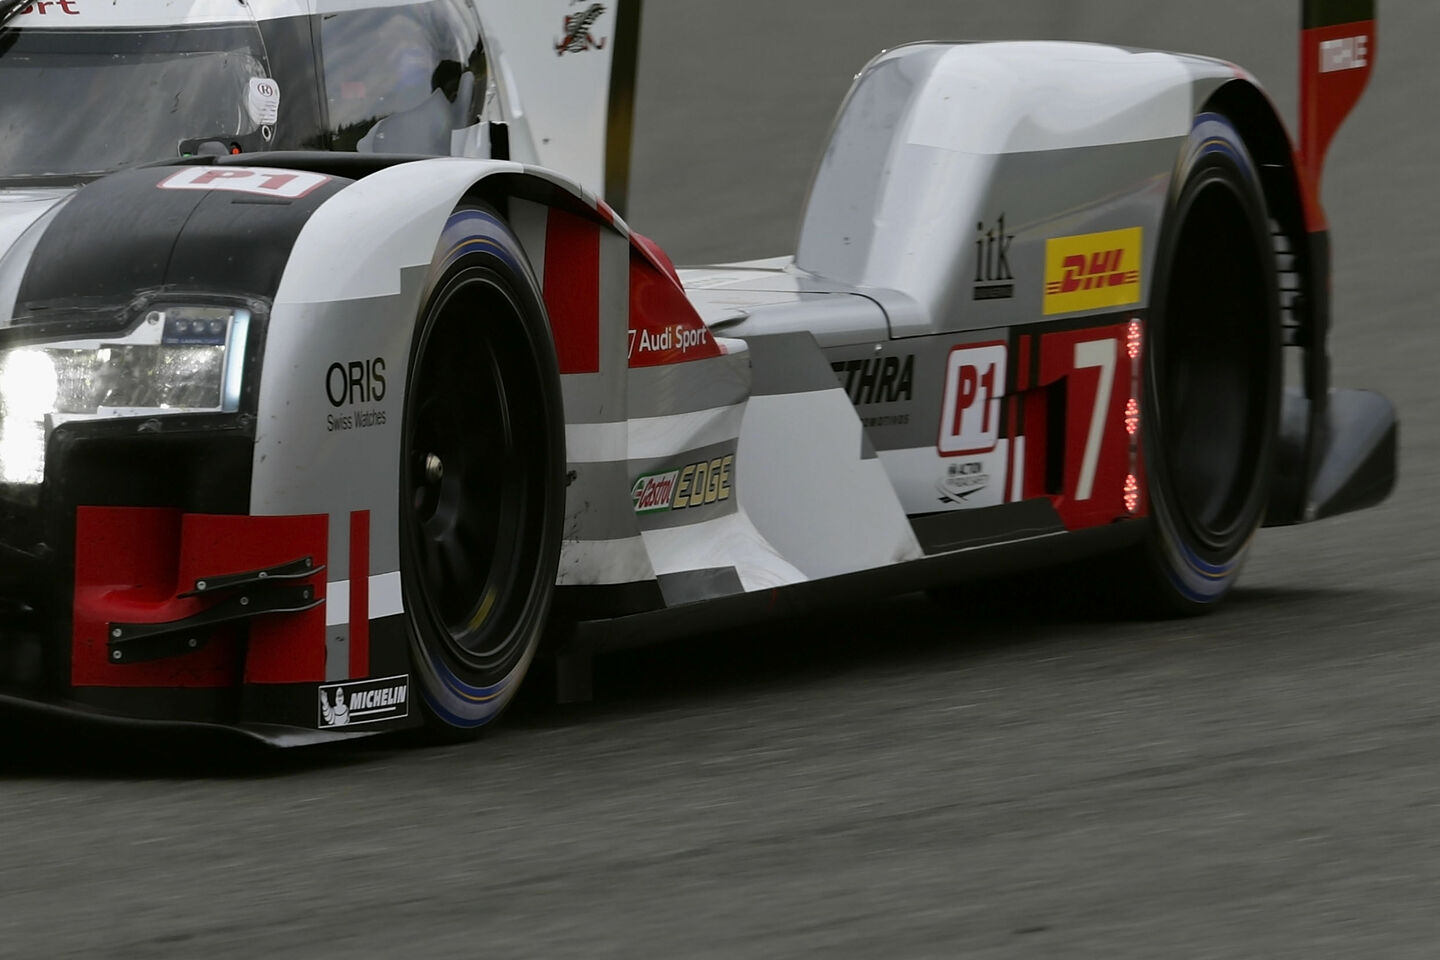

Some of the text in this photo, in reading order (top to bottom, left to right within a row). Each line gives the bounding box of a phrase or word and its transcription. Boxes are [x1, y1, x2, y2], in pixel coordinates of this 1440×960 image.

[189, 169, 298, 189] P1
[974, 211, 1015, 282] itk
[1060, 249, 1124, 294] DHL
[639, 326, 672, 353] Audi
[676, 325, 707, 353] Sport
[326, 357, 386, 407] ORIS
[831, 354, 915, 406] THRA
[951, 362, 997, 436] P1
[327, 408, 386, 432] Swiss Watches
[1073, 338, 1118, 501] 7
[638, 454, 734, 510] Castrol EDGE
[349, 685, 407, 710] MICHELIN
